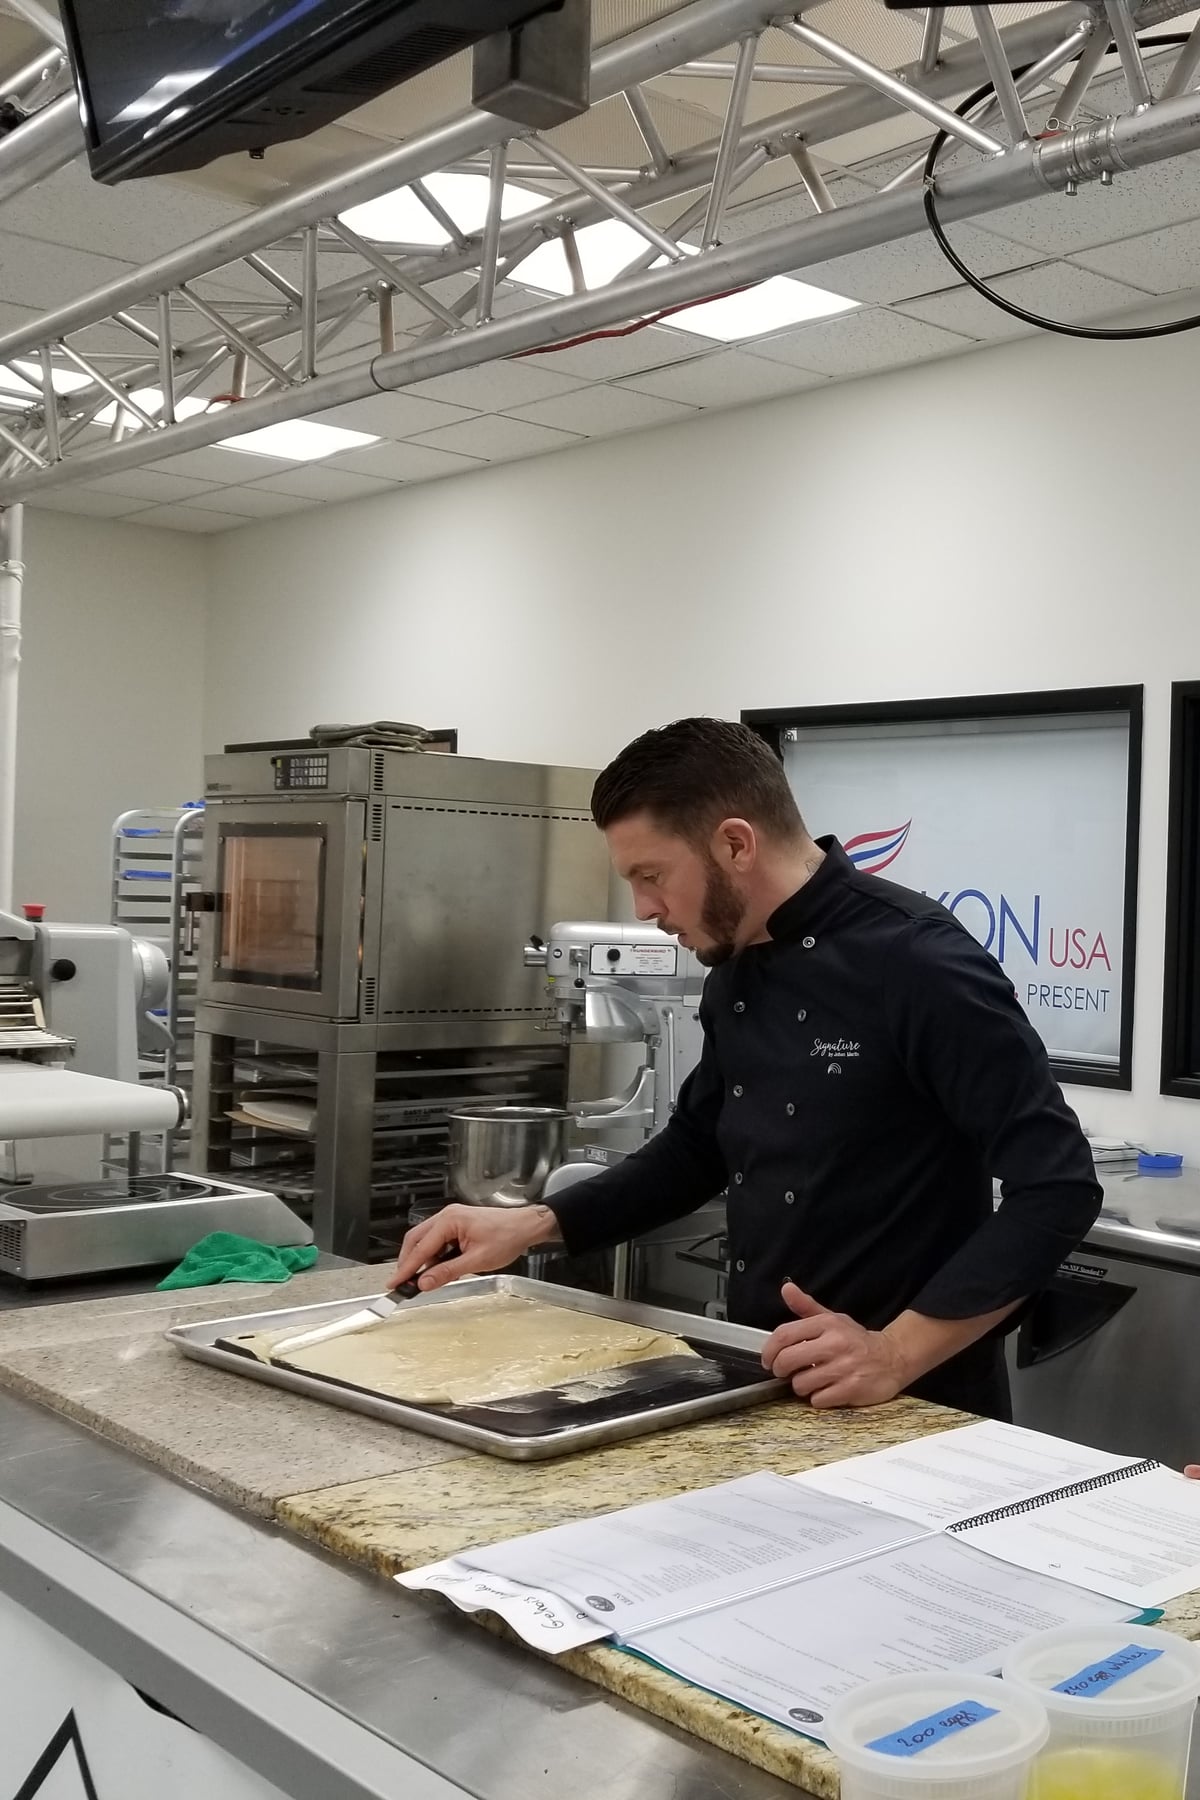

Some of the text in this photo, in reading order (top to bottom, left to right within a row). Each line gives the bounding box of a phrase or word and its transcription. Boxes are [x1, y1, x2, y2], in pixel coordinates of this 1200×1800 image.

[1050, 928, 1111, 971] USA
[1027, 983, 1110, 1012] PRESENT
[810, 1037, 861, 1057] Signature
[897, 1727, 935, 1747] 200
